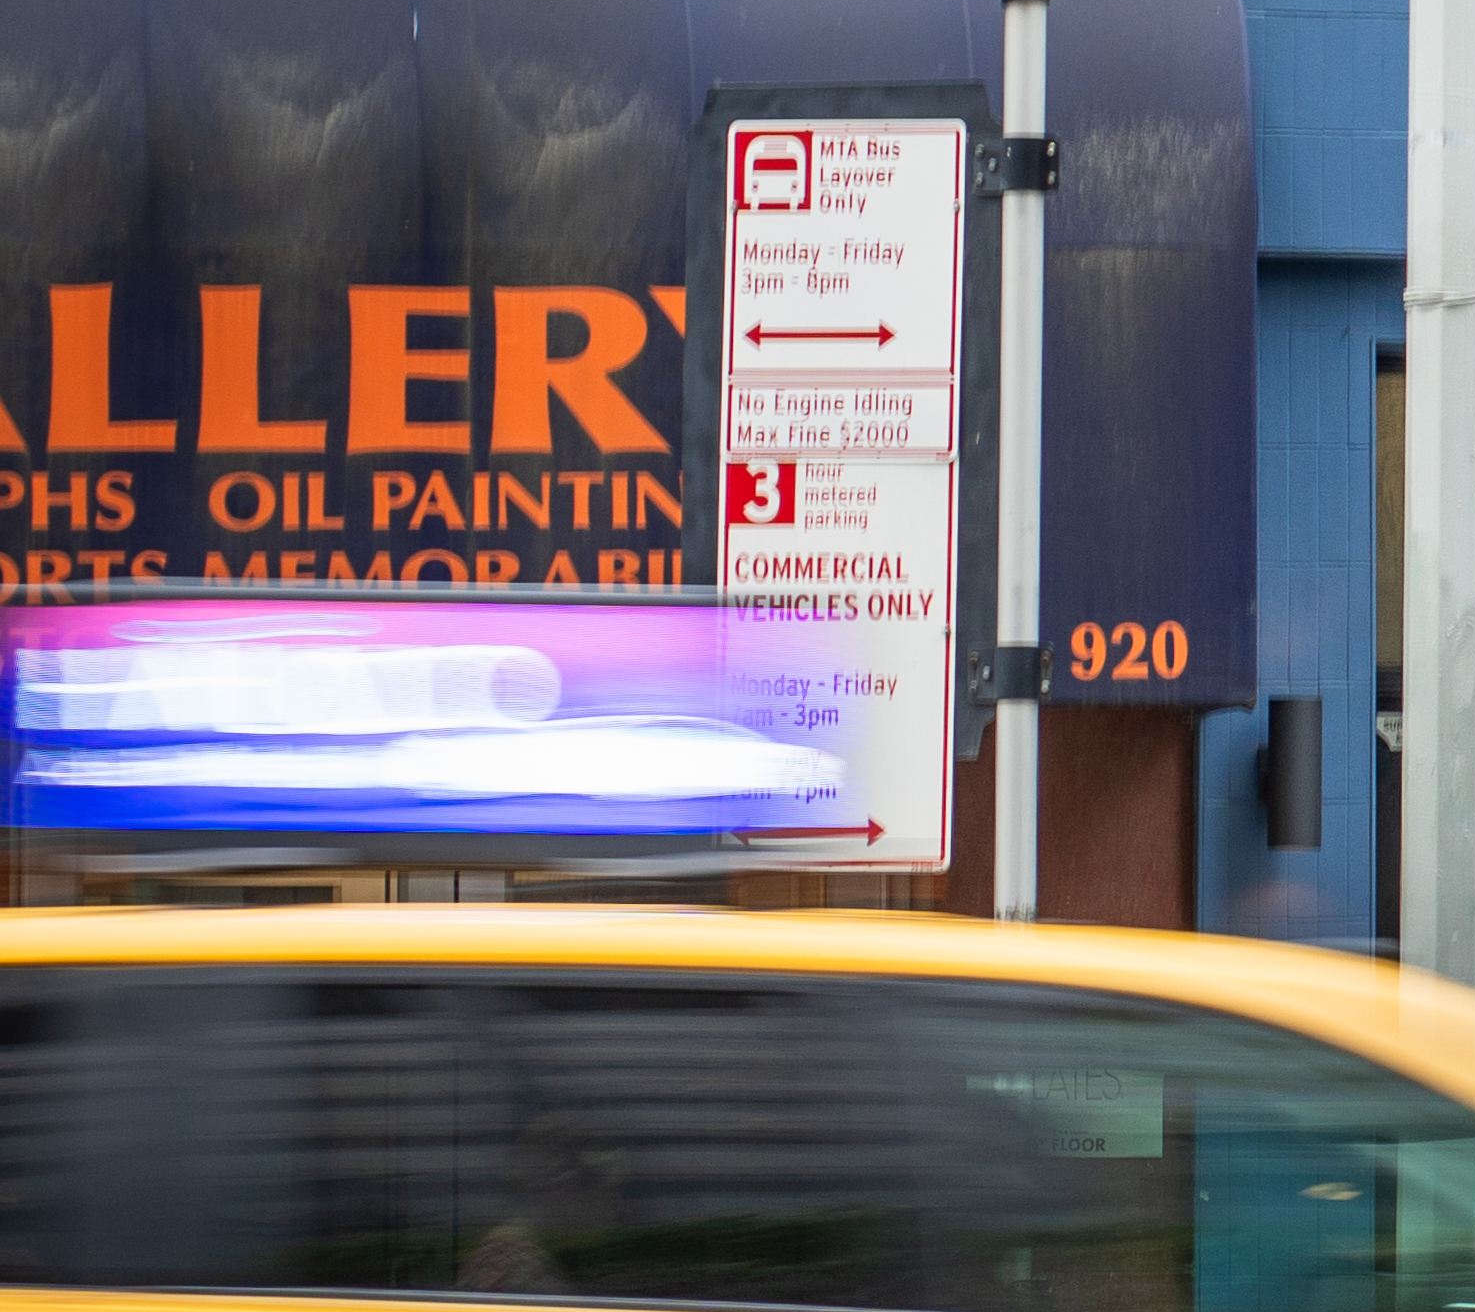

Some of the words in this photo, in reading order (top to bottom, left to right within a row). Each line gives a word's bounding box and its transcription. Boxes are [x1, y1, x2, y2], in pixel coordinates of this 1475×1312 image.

[820, 135, 858, 160] MTA
[867, 135, 901, 161] Bus
[819, 164, 897, 192] Layover
[820, 189, 867, 218] Only
[743, 238, 821, 269] Monday
[843, 238, 905, 270] Friday
[741, 267, 783, 299] 3pm
[0, 282, 686, 455] LLER
[738, 389, 765, 416] No
[774, 387, 845, 421] Engine
[855, 387, 914, 421] Idling
[737, 420, 779, 448] Max
[789, 420, 830, 448] Fine
[840, 418, 909, 450] $2000
[208, 471, 344, 533] OIL
[372, 469, 683, 531] PAINTIN
[743, 460, 780, 523] 3
[805, 461, 845, 482] hour
[804, 482, 877, 507] metered
[804, 505, 868, 534] parking
[735, 552, 909, 584] COMMERCIAL
[733, 590, 858, 622] VEHICLES
[867, 589, 934, 622] ONLY
[1070, 621, 1189, 681] 920
[731, 673, 810, 701] Monday
[833, 670, 898, 701] Friday
[794, 703, 839, 731] 3pm
